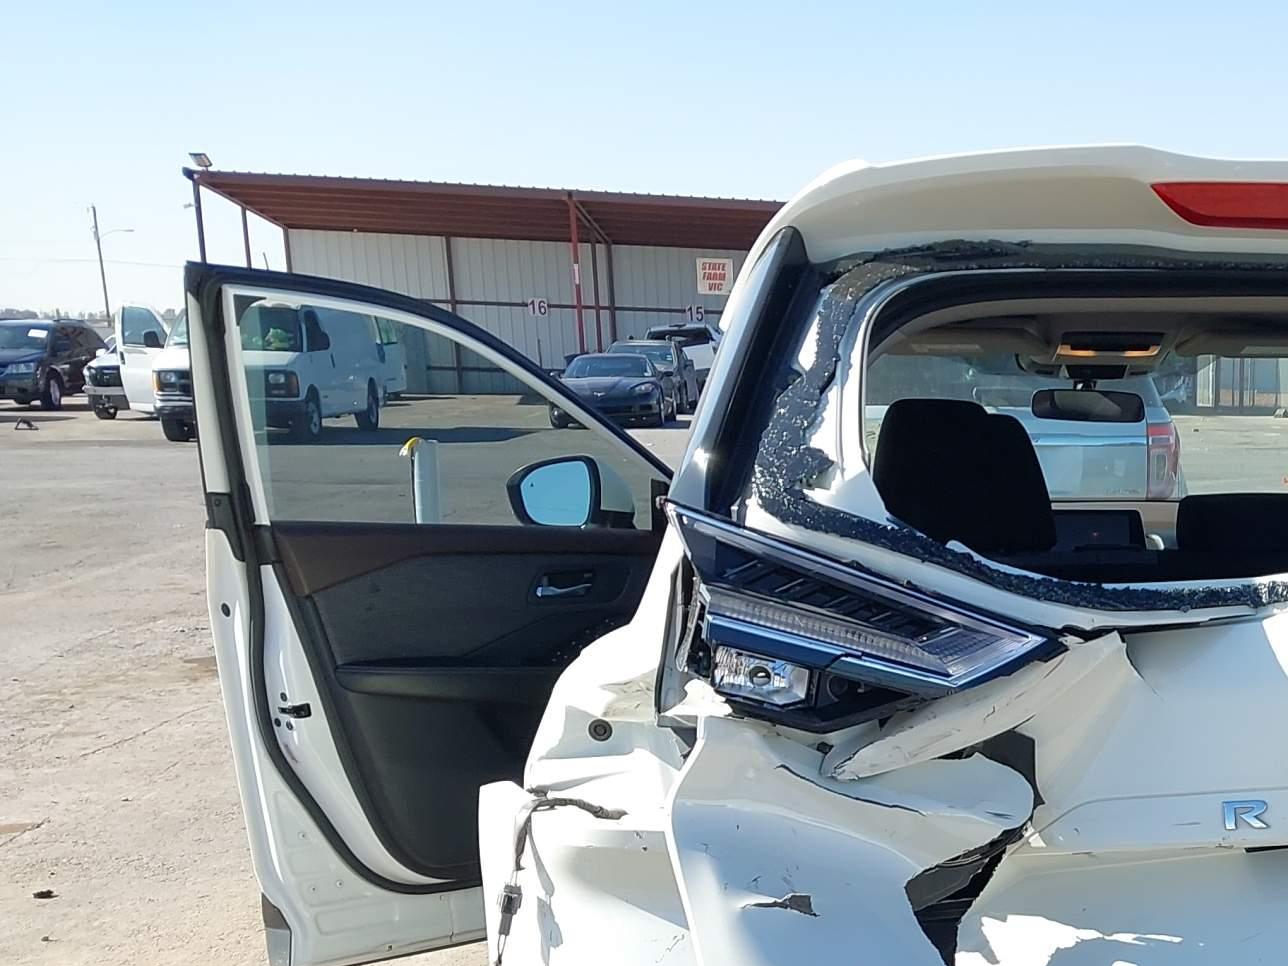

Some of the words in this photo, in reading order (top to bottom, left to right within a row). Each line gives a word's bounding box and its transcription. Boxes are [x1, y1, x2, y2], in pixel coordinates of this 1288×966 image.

[701, 262, 727, 271] STATE
[702, 272, 727, 281] FARM
[708, 282, 724, 291] VIC
[528, 299, 547, 316] 16
[686, 305, 704, 322] 15
